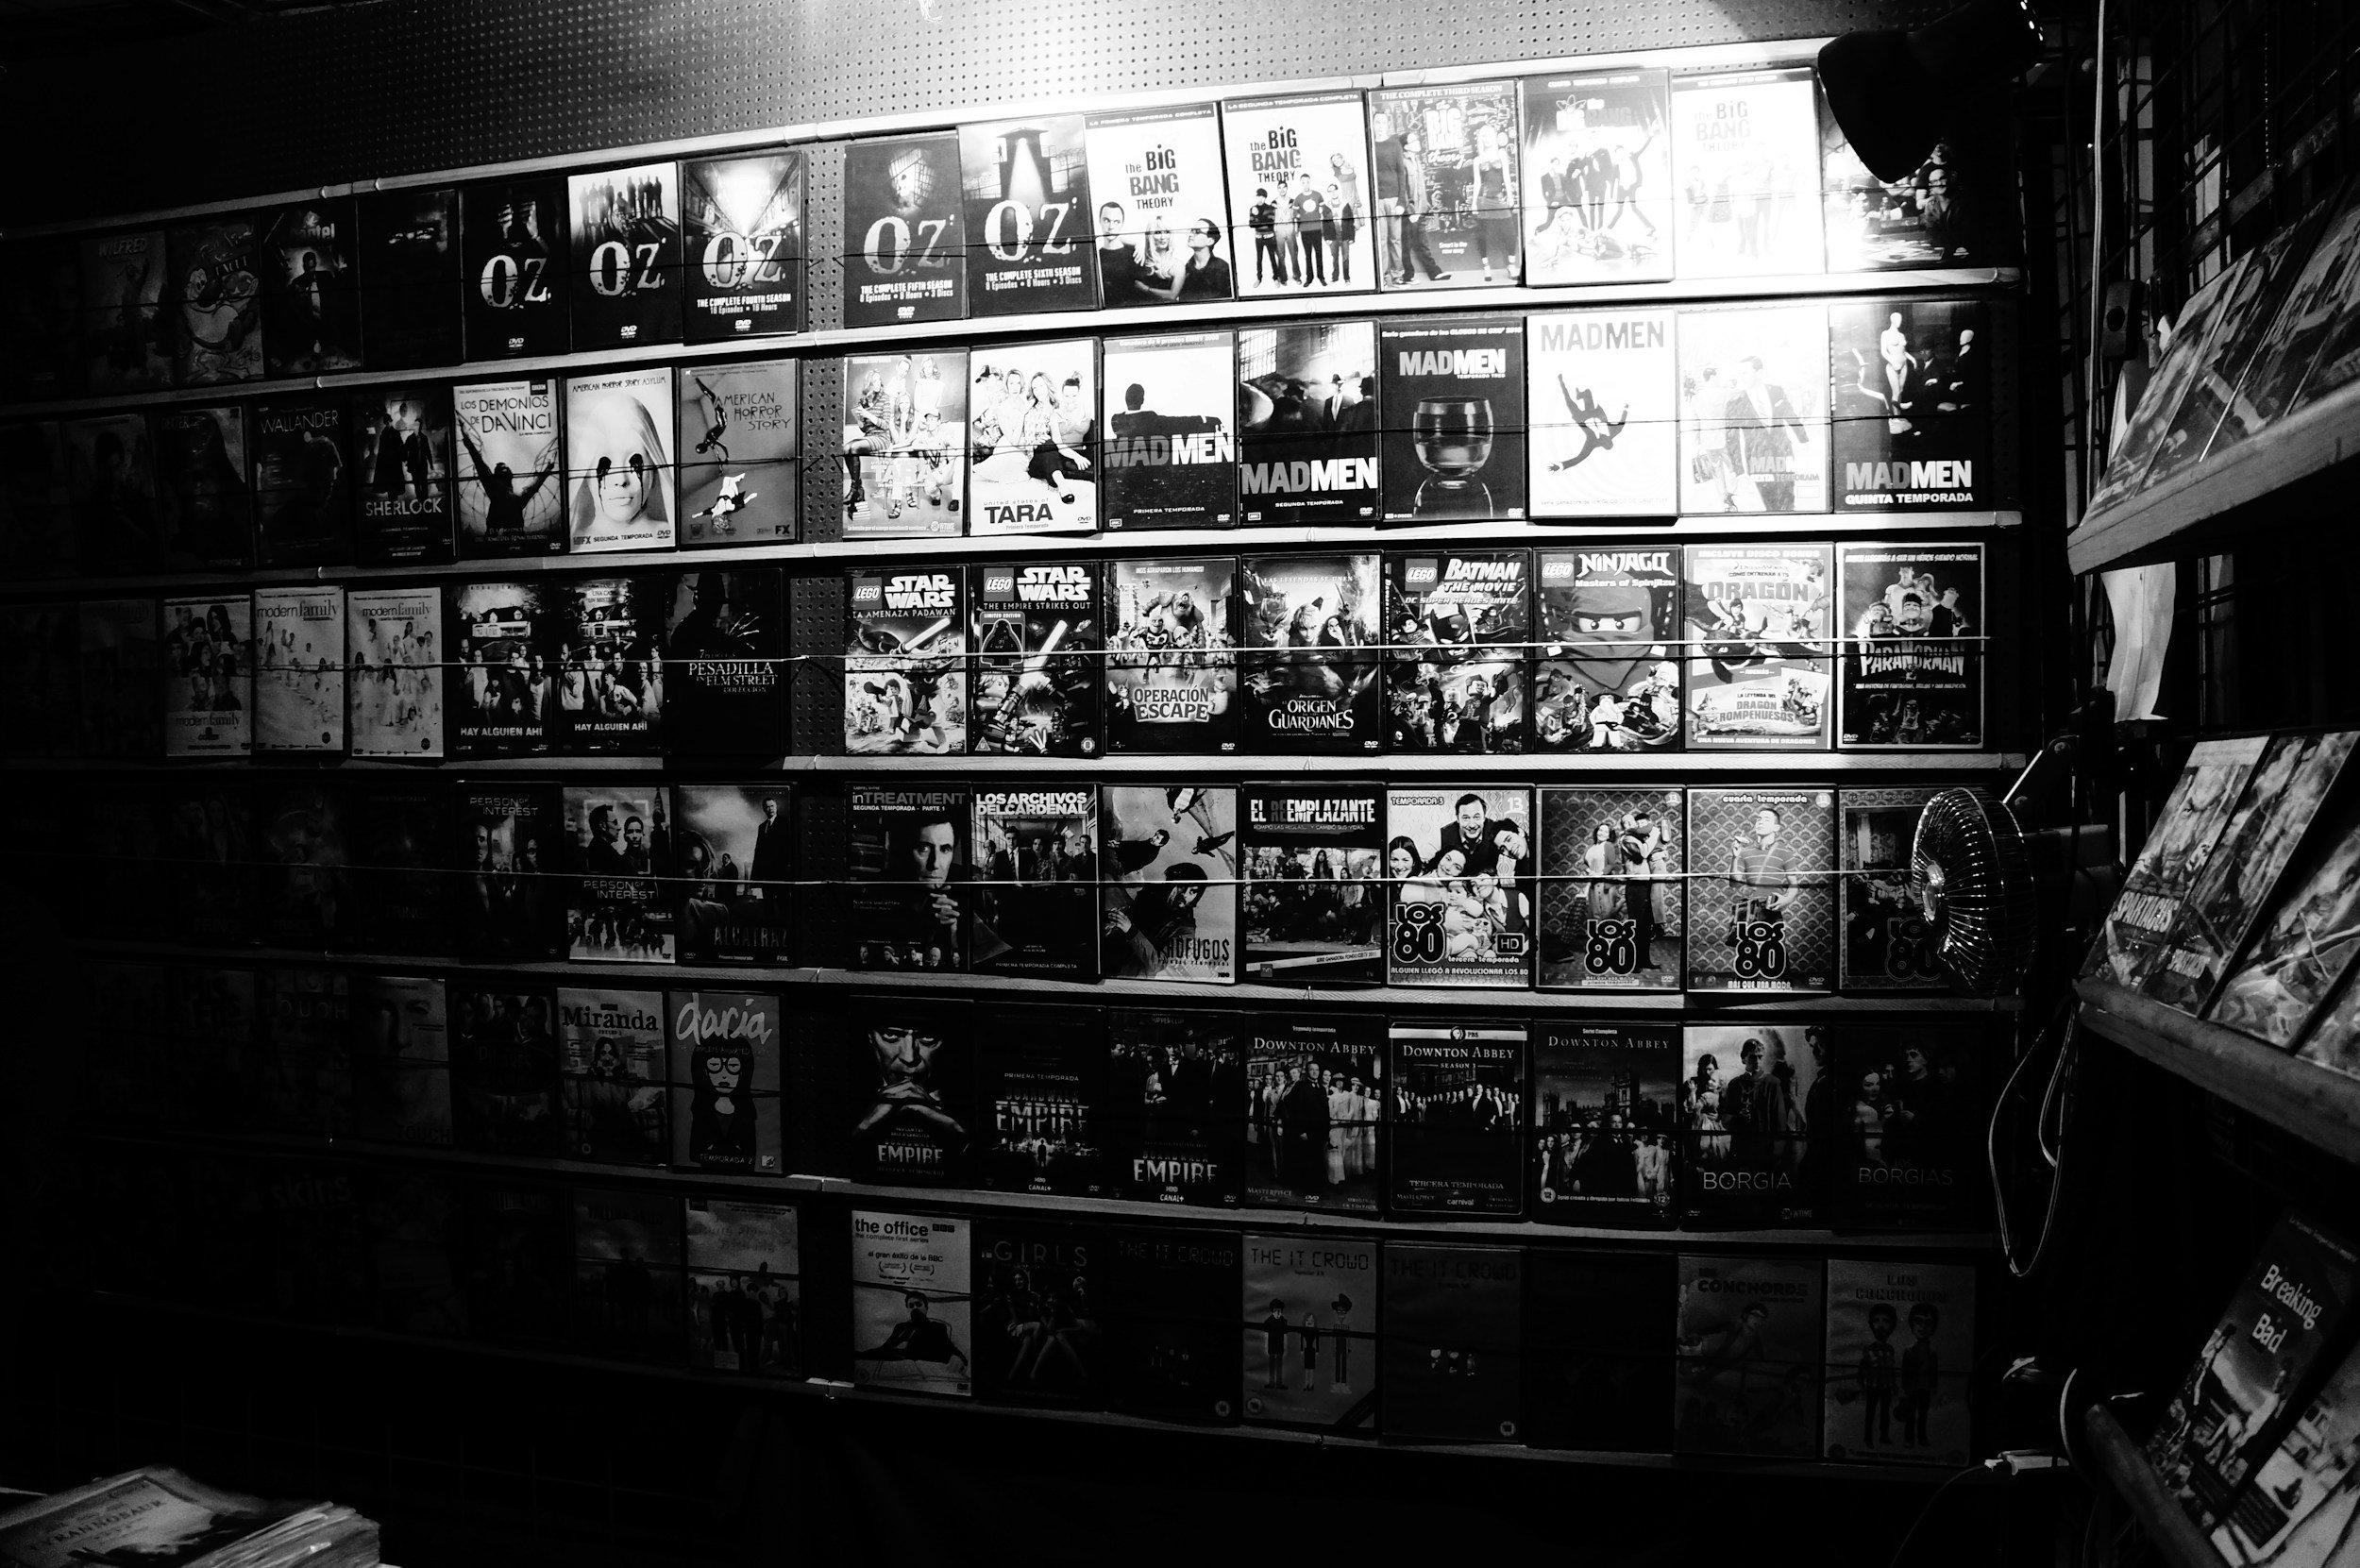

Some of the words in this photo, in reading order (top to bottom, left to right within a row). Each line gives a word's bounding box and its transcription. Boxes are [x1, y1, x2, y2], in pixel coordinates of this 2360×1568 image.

[1380, 92, 1398, 101] THE
[1399, 88, 1442, 99] COMPLETE
[1443, 86, 1471, 96] THIRD
[1471, 84, 1503, 93] SEASON
[1695, 119, 1750, 142] BANG
[1250, 142, 1266, 151] the
[1125, 162, 1142, 173] the
[1251, 148, 1301, 172] BANG
[1129, 173, 1179, 196] BANG
[1258, 171, 1295, 183] THEORY
[1136, 194, 1173, 210] THEORY
[1054, 266, 1081, 277] SEASON
[927, 279, 952, 290] SEASON
[767, 294, 791, 303] SEASON
[572, 382, 598, 393] AMERICAN
[644, 377, 666, 385] ASYLUM
[461, 399, 476, 410] LOS
[479, 395, 549, 413] DEMONIOS
[716, 393, 775, 410] AMERICAN
[734, 405, 783, 422] HORROR
[260, 411, 339, 433] WALLANDER
[748, 418, 792, 430] STORY
[1845, 494, 1895, 505] QUINTA
[1896, 492, 1974, 503] TEMPORADA
[365, 498, 443, 516] SHERLOCK
[984, 503, 1053, 524] TARA
[620, 532, 653, 541] TEMPORADA
[776, 525, 790, 534] FX
[1444, 558, 1521, 581] BATMAN
[1542, 562, 1574, 578] LEGO
[1576, 552, 1675, 577] NINJAGO
[1017, 566, 1091, 584] STAR
[1406, 567, 1437, 582] LEGO
[885, 574, 955, 593] STAR
[985, 577, 1013, 593] LEGO
[1443, 582, 1472, 592] THE
[1472, 582, 1517, 592] MOVIE
[1575, 579, 1611, 587] Masters
[854, 586, 881, 601] LEGO
[1017, 582, 1091, 601] WARS
[885, 591, 955, 609] WARS
[852, 611, 863, 619] LA
[866, 610, 910, 618] AMENAZA
[912, 608, 956, 616] PADAWAN
[689, 662, 773, 676] PESADILLA
[706, 676, 729, 686] ELM
[731, 674, 778, 686] STREET
[1135, 684, 1209, 702] OPERACIÓN
[1136, 702, 1209, 721] ESCAPE
[1287, 699, 1337, 713] ORIGEN
[1268, 709, 1354, 733] GUARDIANES
[1719, 710, 1794, 722] ROMPEHUESOS
[461, 727, 479, 736] HAY
[481, 727, 523, 736] ALGUIEN
[594, 722, 629, 731] ALGUIEN
[469, 797, 520, 806] PERSON
[1757, 794, 1808, 804] temporada
[482, 806, 538, 817] INTEREST
[1250, 800, 1267, 823] EL
[584, 881, 634, 889] PERSON
[598, 890, 655, 899] INTEREST
[1393, 922, 1446, 963] 80
[1500, 939, 1520, 950] HD
[1584, 937, 1637, 975] 80
[1733, 939, 1787, 979] 80
[1423, 966, 1443, 975] LLEGÓ
[562, 1006, 659, 1030] Miranda
[676, 992, 772, 1045] daria
[1254, 1037, 1328, 1052] DOWNTON
[1330, 1041, 1376, 1054] ABBEY
[1548, 1036, 1619, 1048] DOWNTON
[1626, 1038, 1669, 1049] ABBEY
[1403, 1045, 1469, 1057] DOWNTON
[1472, 1046, 1514, 1060] ABBEY
[700, 1154, 747, 1164] TEMPORADA
[877, 1145, 944, 1164] EMPIRE
[1133, 1159, 1218, 1183] EMPIRE
[1859, 1168, 1953, 1186] BORGIAS
[1409, 1180, 1449, 1189] TERCERA
[1451, 1181, 1504, 1189] TEMPORADA
[1703, 1172, 1792, 1189] BORGIA
[855, 1219, 880, 1233] the
[884, 1221, 928, 1237] office
[994, 1240, 1087, 1268] GIRLS
[1252, 1248, 1281, 1266] THE
[1290, 1251, 1305, 1266] IT
[1312, 1253, 1369, 1270] CROWD
[1698, 1279, 1808, 1296] CONCHORDS
[2261, 1263, 2322, 1330] Breaking
[2251, 1313, 2287, 1354] Bad
